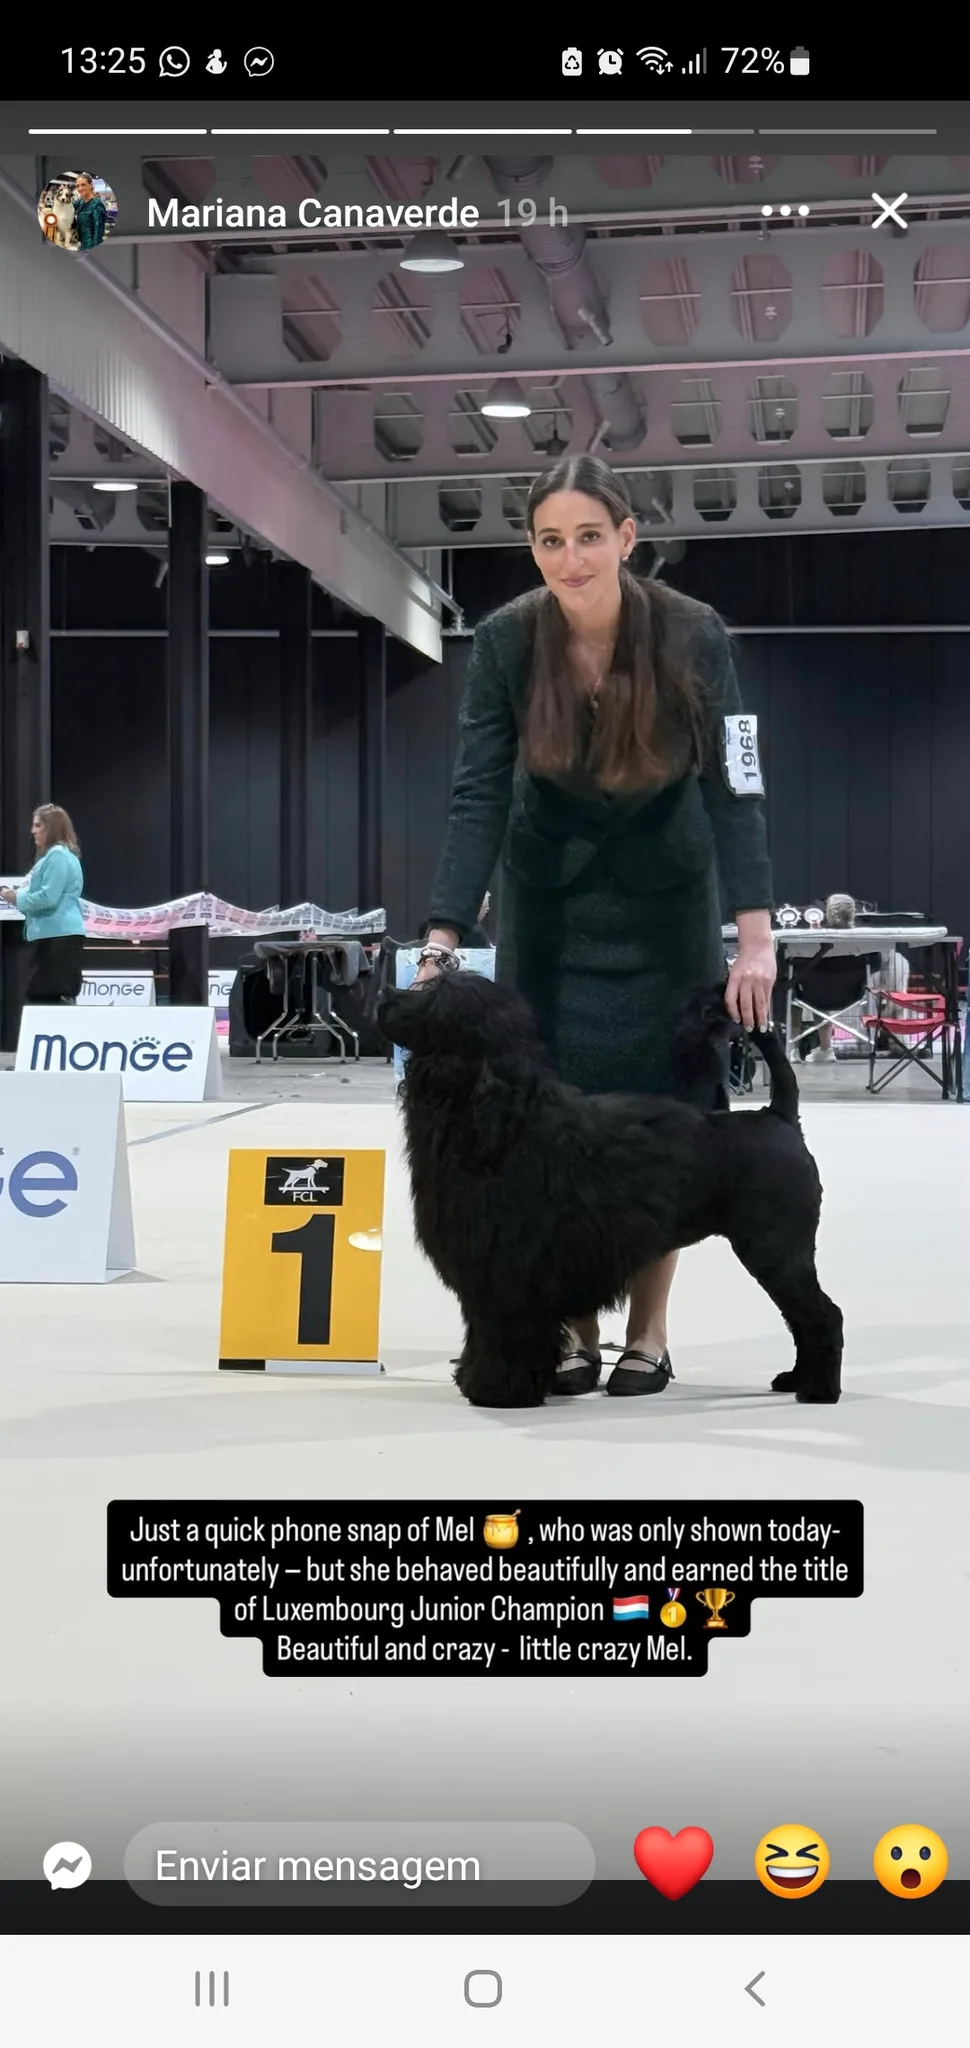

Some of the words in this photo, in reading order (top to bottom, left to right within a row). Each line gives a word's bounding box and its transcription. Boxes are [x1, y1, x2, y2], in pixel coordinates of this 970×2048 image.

[738, 719, 758, 783] 1968
[293, 1191, 318, 1203] FCL
[271, 1213, 336, 1345] 1
